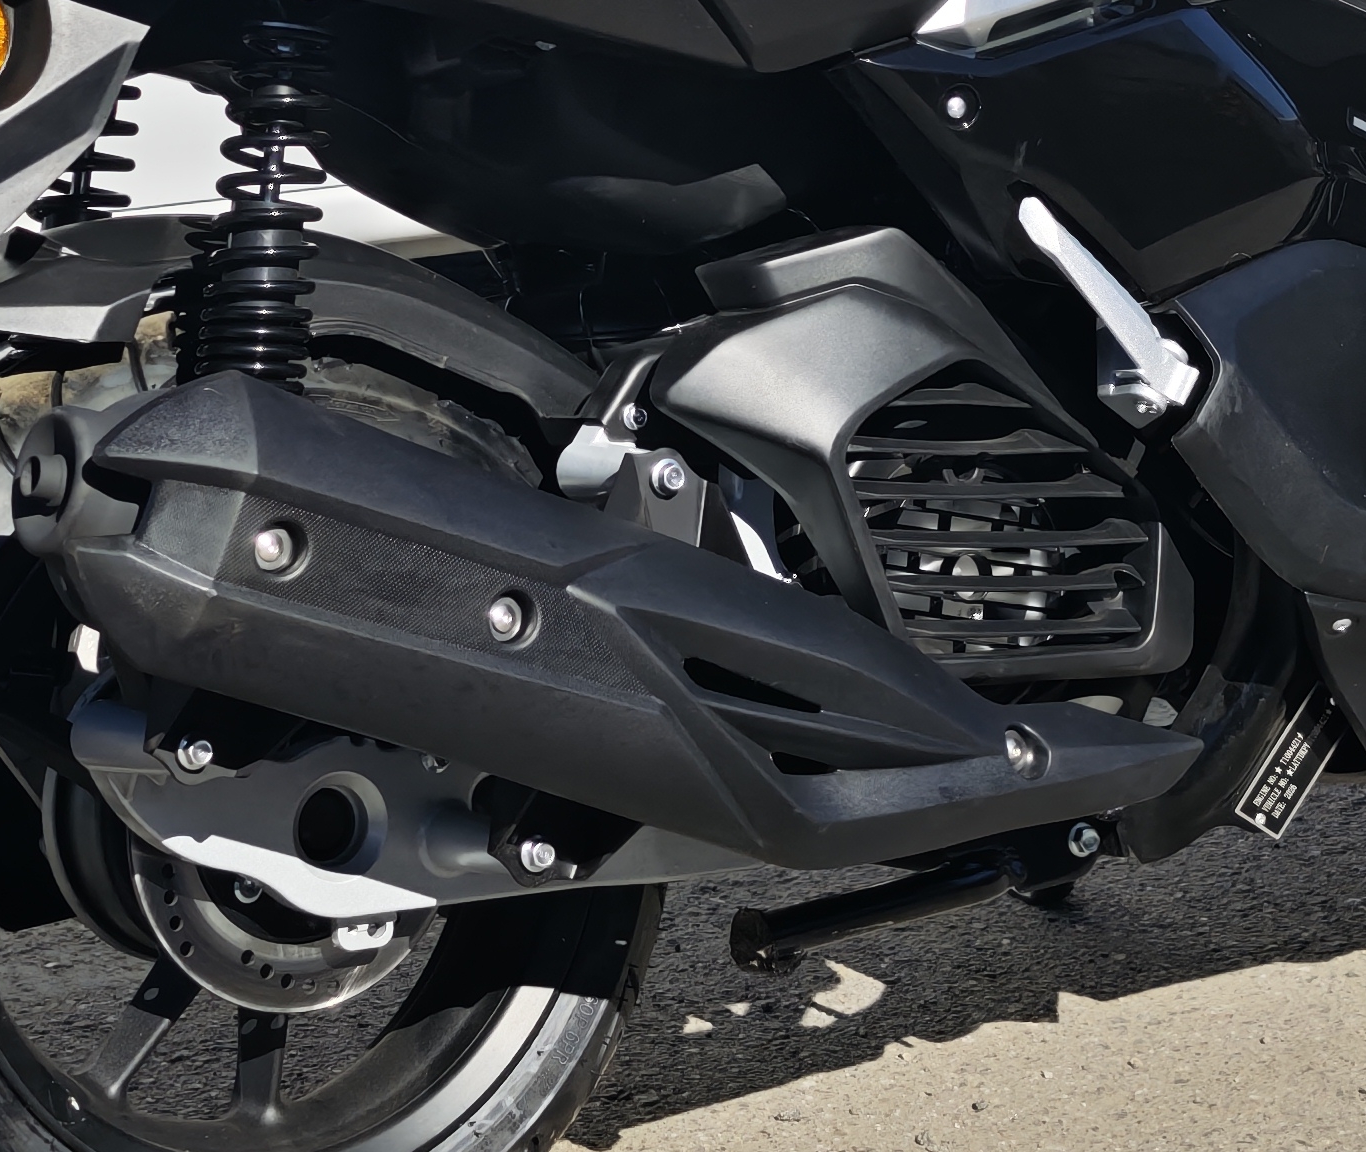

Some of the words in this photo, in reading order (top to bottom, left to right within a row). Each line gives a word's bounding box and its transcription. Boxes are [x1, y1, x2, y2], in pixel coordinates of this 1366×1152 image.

[1252, 783, 1271, 807] ENGINE
[1261, 786, 1281, 812] VEHICLE
[1270, 799, 1287, 819] DATE:
